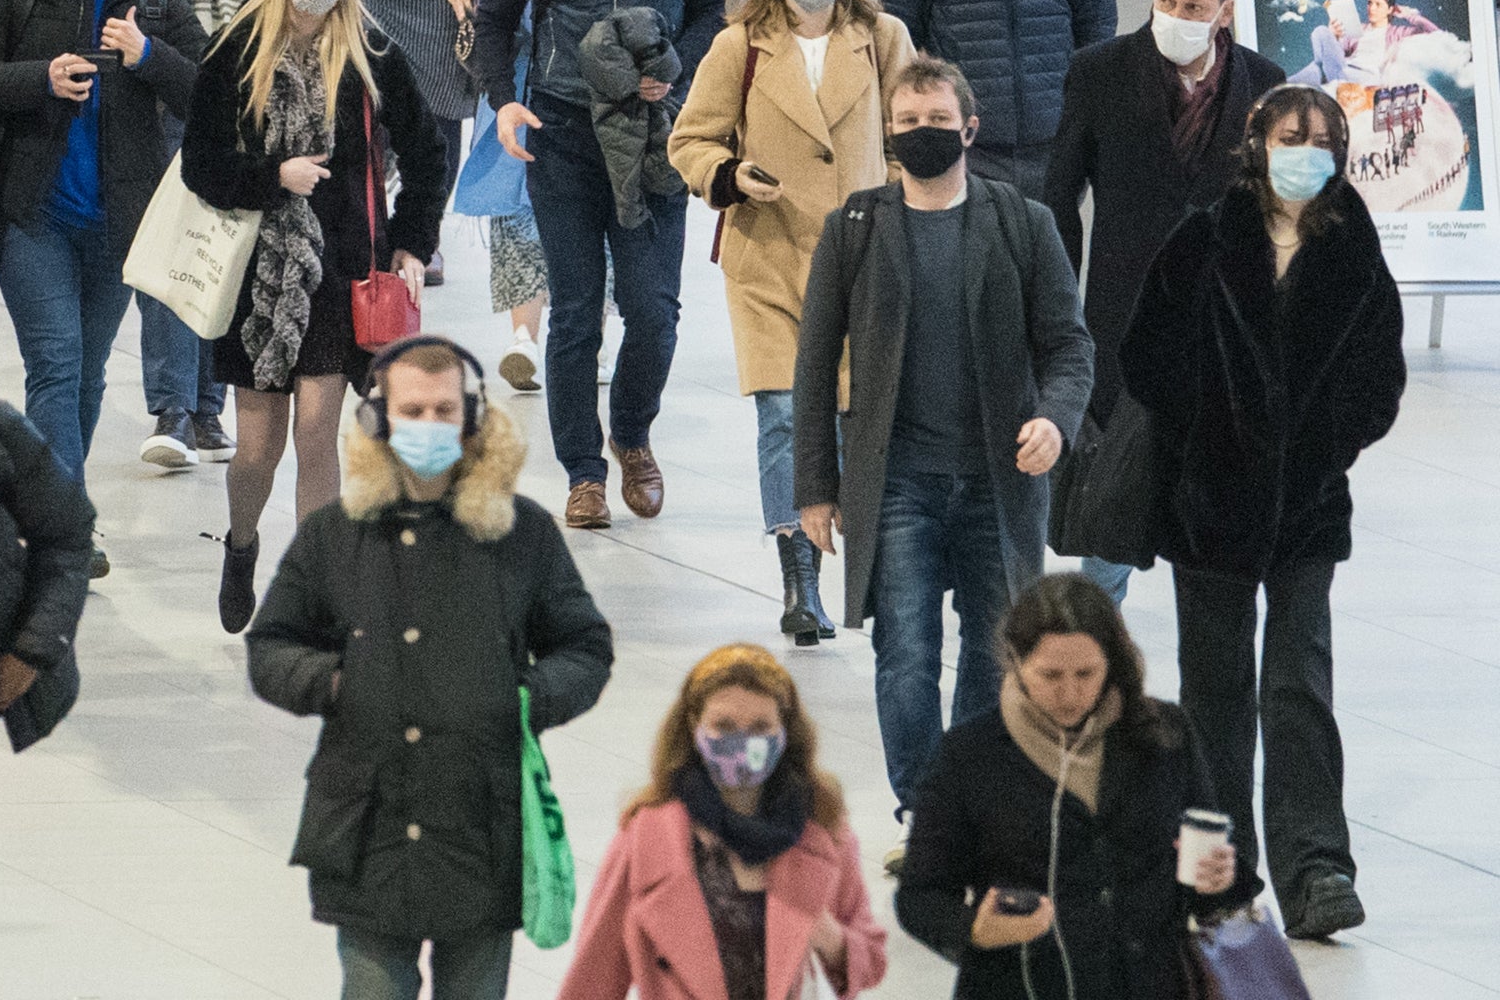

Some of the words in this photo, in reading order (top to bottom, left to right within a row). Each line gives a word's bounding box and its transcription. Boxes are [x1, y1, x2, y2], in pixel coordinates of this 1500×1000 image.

[1427, 221, 1451, 230] South
[1452, 221, 1487, 230] Western
[1435, 230, 1467, 240] Railway
[168, 268, 206, 293] CLOTHES
